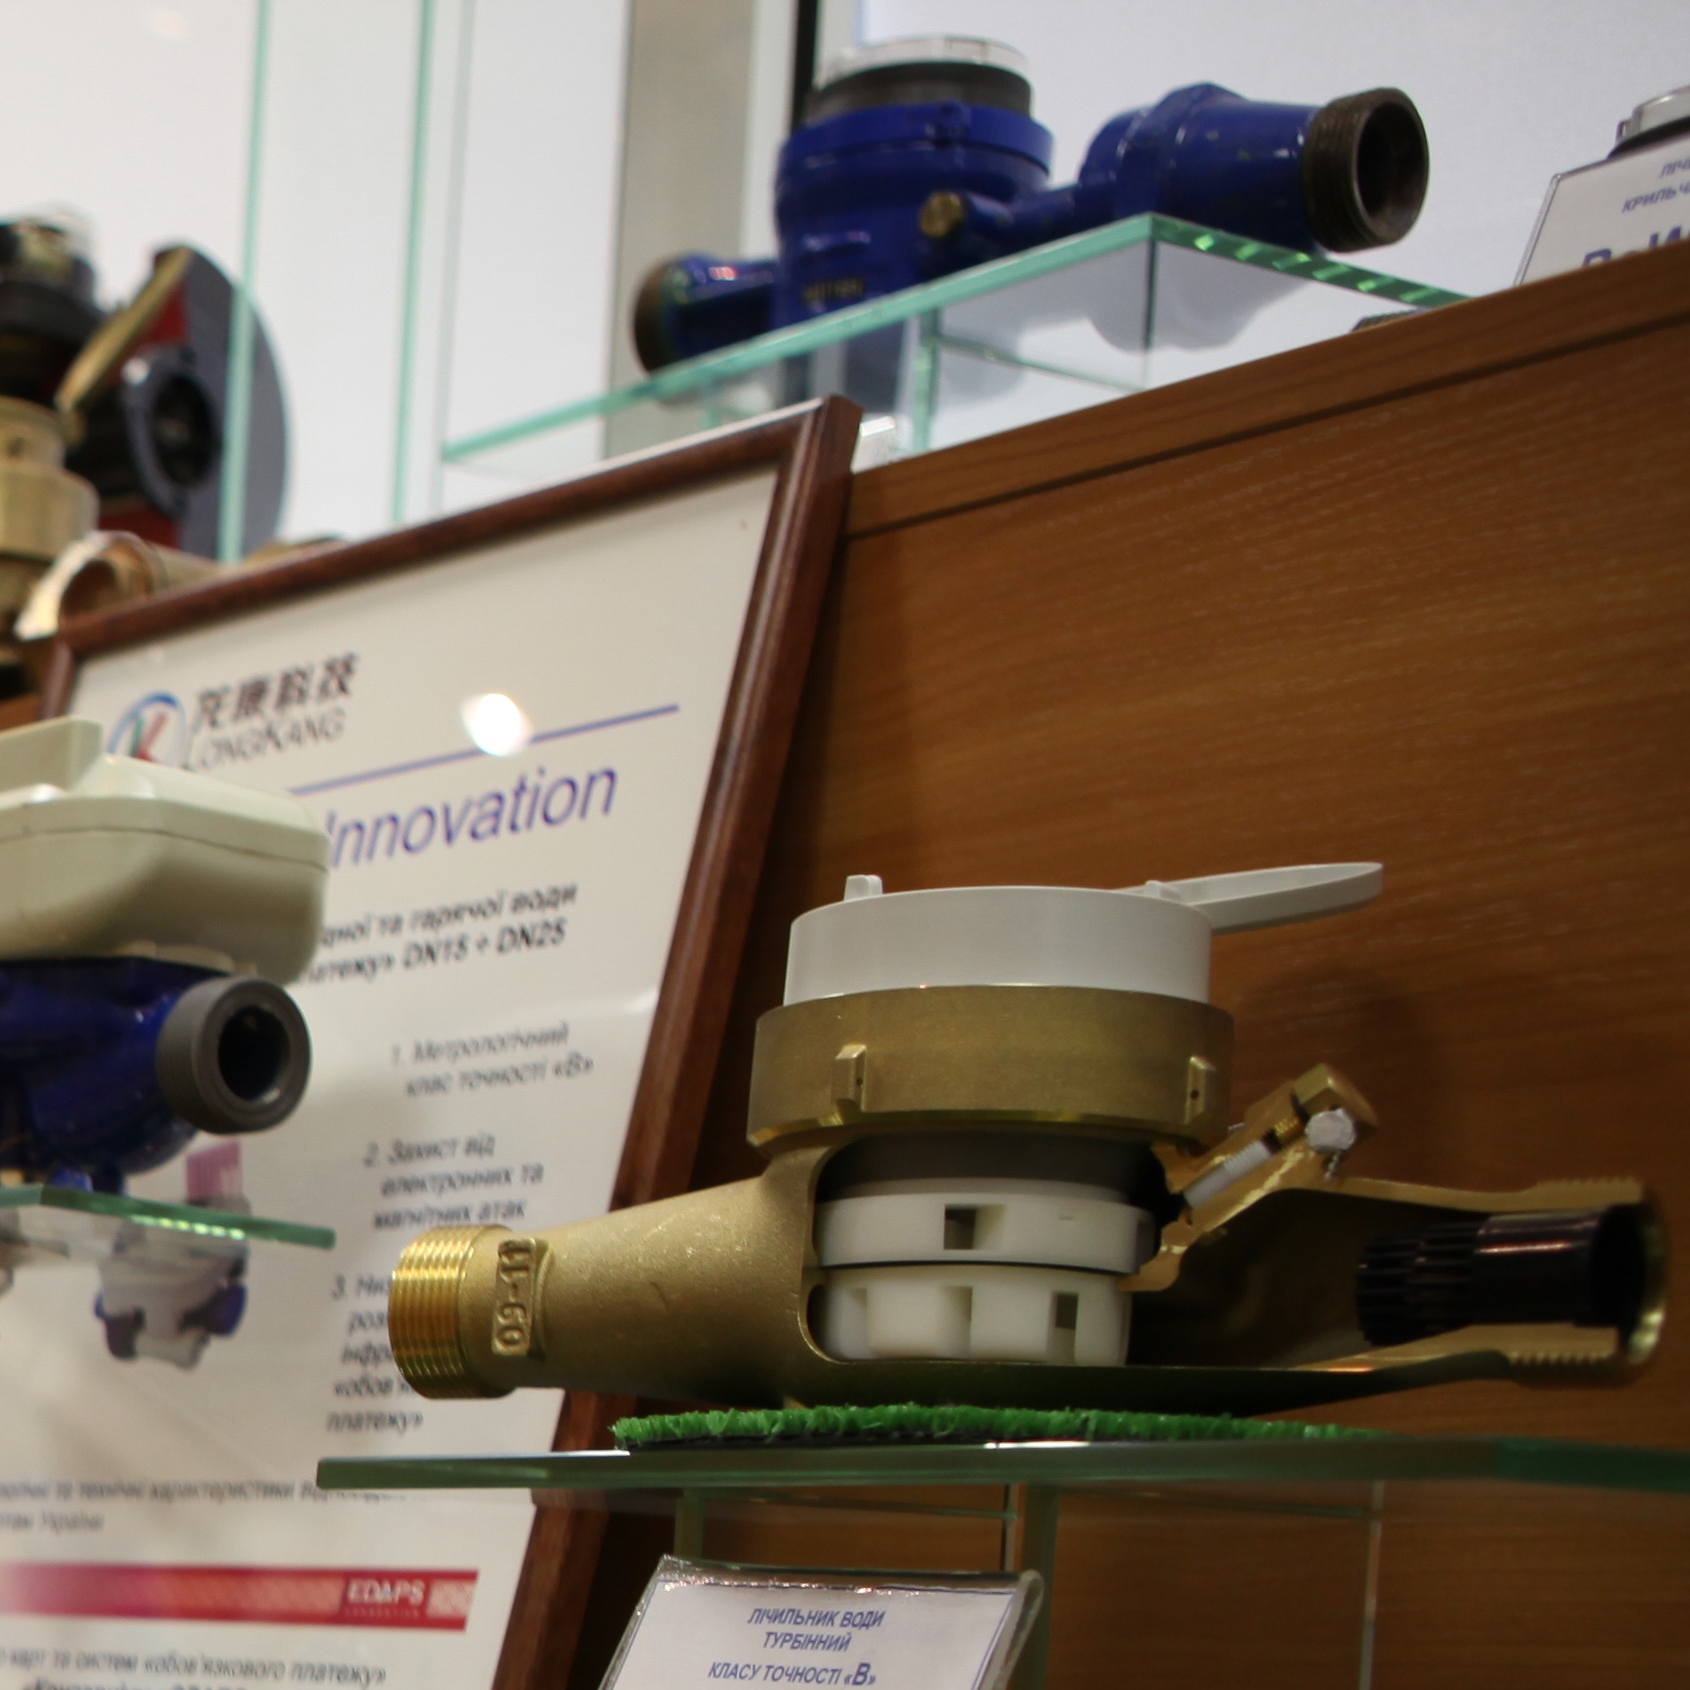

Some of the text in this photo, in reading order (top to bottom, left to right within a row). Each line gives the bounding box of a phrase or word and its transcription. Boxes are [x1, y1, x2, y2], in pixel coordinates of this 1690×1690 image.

[493, 1239, 535, 1352] 09-11
[347, 1577, 426, 1607] EDAPS
[747, 1607, 886, 1631] ЛІЧИЛЬНИК ВОДИ
[762, 1630, 852, 1652] ТУРБІННИЙ
[708, 1662, 760, 1682] КЛАСУ
[762, 1664, 842, 1686] ТОЧНОСТІ
